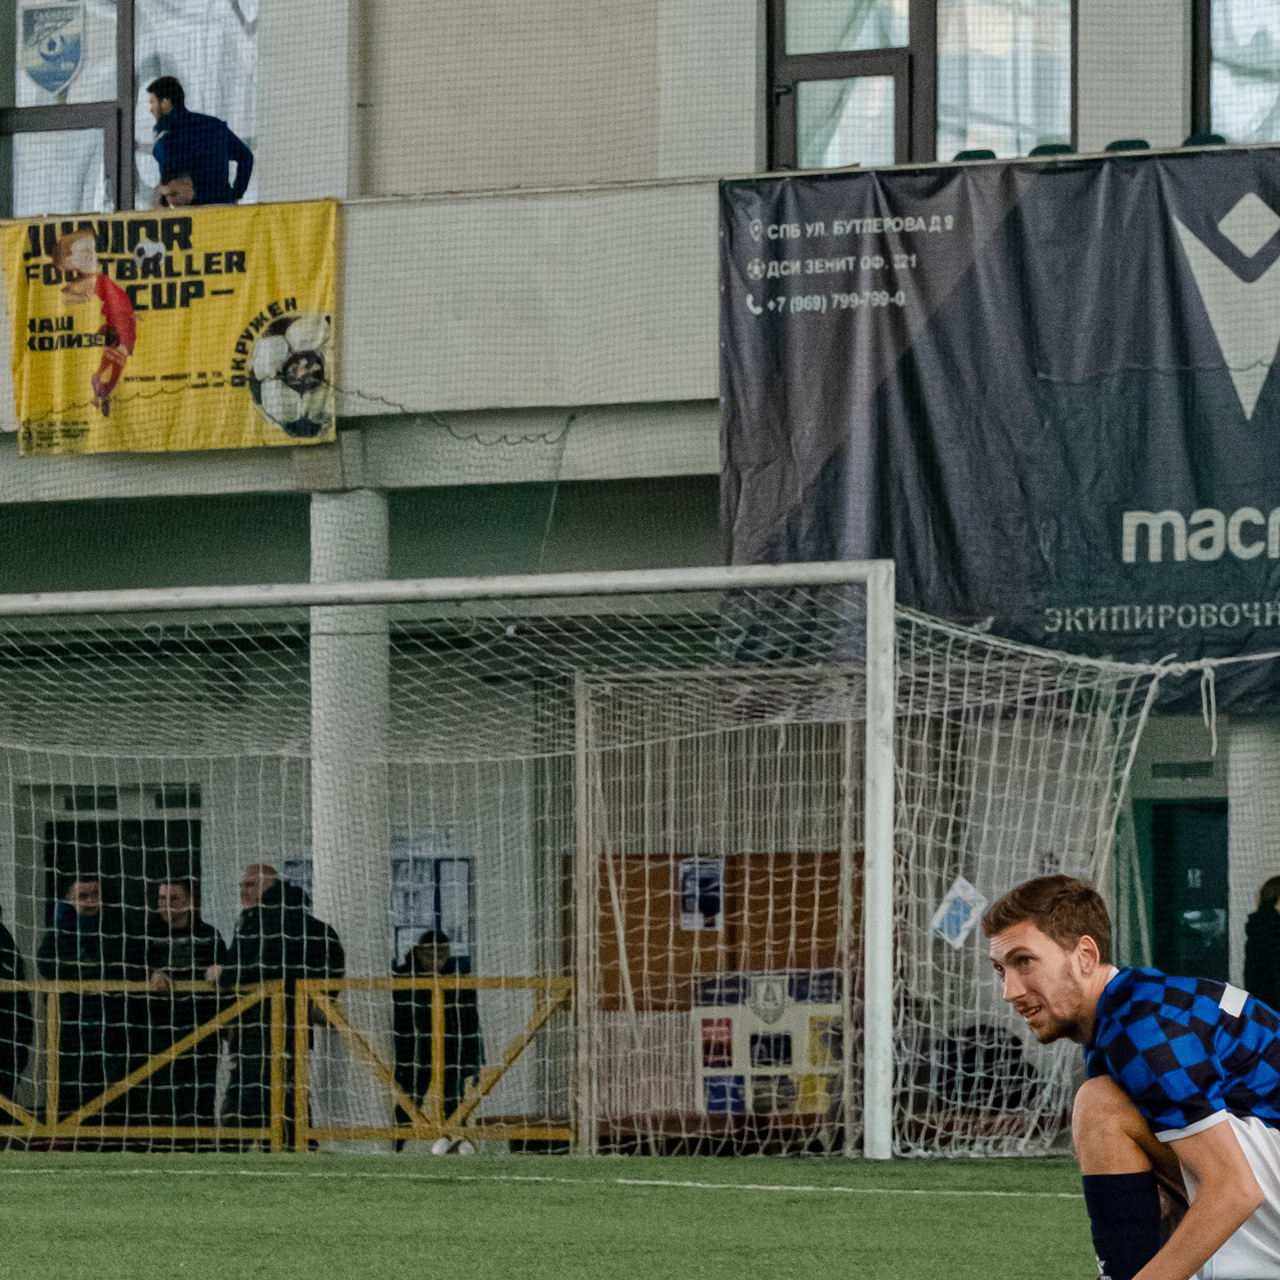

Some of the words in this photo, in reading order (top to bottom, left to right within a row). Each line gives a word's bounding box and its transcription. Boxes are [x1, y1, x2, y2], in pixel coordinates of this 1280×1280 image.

[23, 217, 192, 260] JUNIOR
[768, 223, 800, 240] СПБ
[805, 256, 856, 275] ЗЕНИТ
[127, 280, 205, 310] CUP
[767, 296, 786, 313] +7
